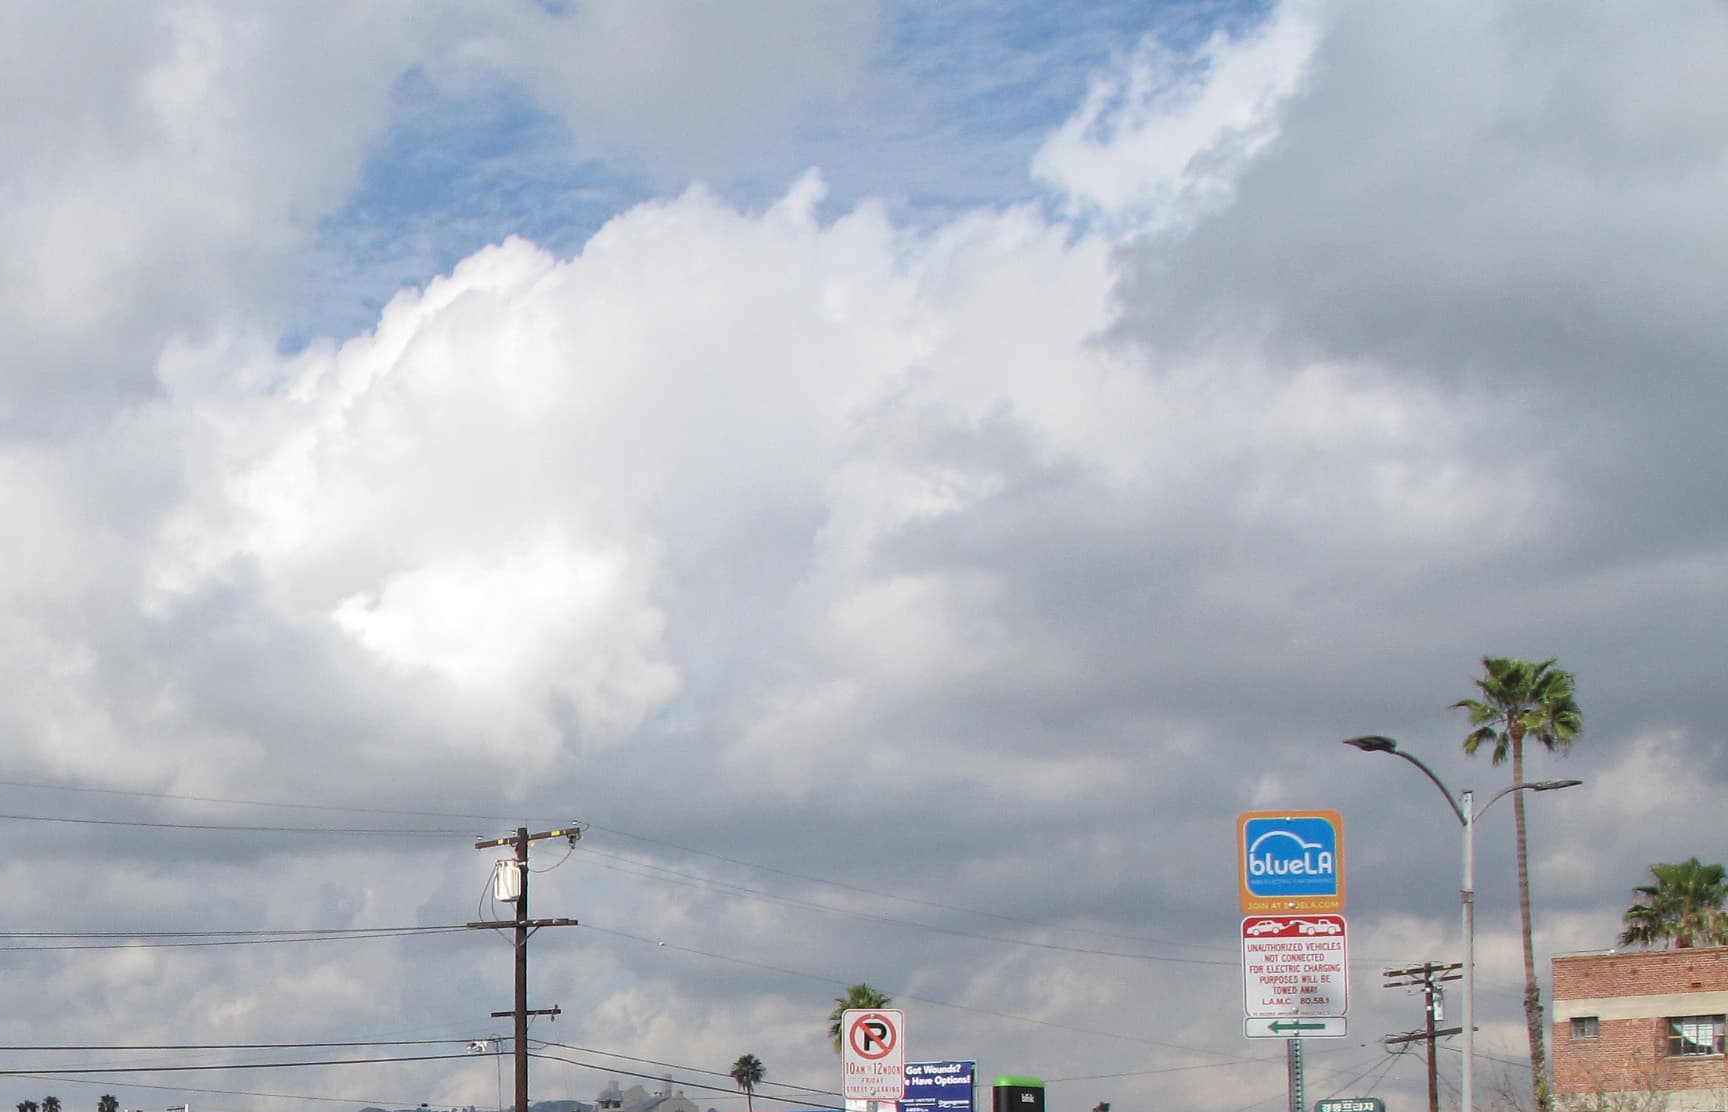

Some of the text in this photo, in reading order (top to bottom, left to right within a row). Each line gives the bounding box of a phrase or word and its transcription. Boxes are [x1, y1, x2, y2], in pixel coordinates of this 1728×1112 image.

[1248, 851, 1332, 876] blueLA
[1248, 902, 1269, 910] JOIN
[1247, 942, 1341, 952] UNAUTHORIZED VEHICLES
[1264, 953, 1324, 962] NOT CONNECTED
[1249, 963, 1341, 974] FOR ELECTRIC CHARGING
[1259, 974, 1330, 984] PURPOSES WILL BE
[1272, 986, 1318, 995] TOWED AWAY
[845, 1062, 865, 1075] 10AM
[905, 1064, 961, 1075] Got Wounds?
[911, 1076, 933, 1086] Have
[934, 1074, 971, 1087] Options!
